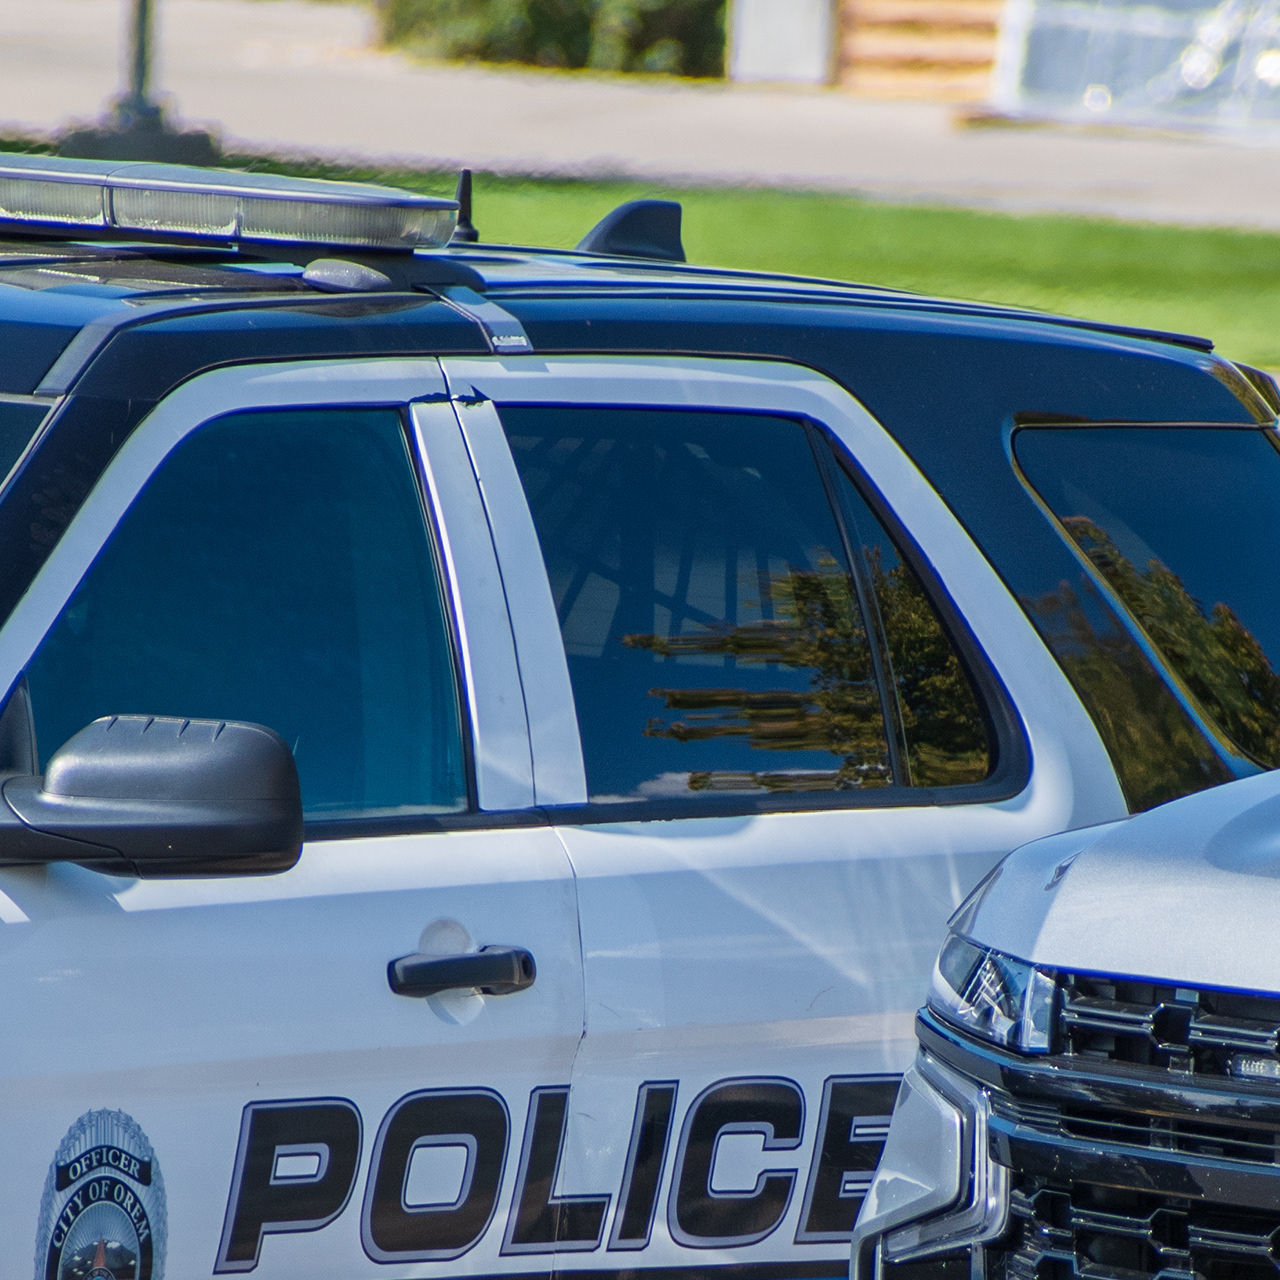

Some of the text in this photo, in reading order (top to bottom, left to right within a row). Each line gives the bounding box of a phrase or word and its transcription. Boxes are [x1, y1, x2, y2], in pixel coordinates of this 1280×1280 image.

[68, 1147, 140, 1180] OFFICER
[212, 1073, 905, 1275] POLICE
[53, 1180, 150, 1248] CITY OF OREM
